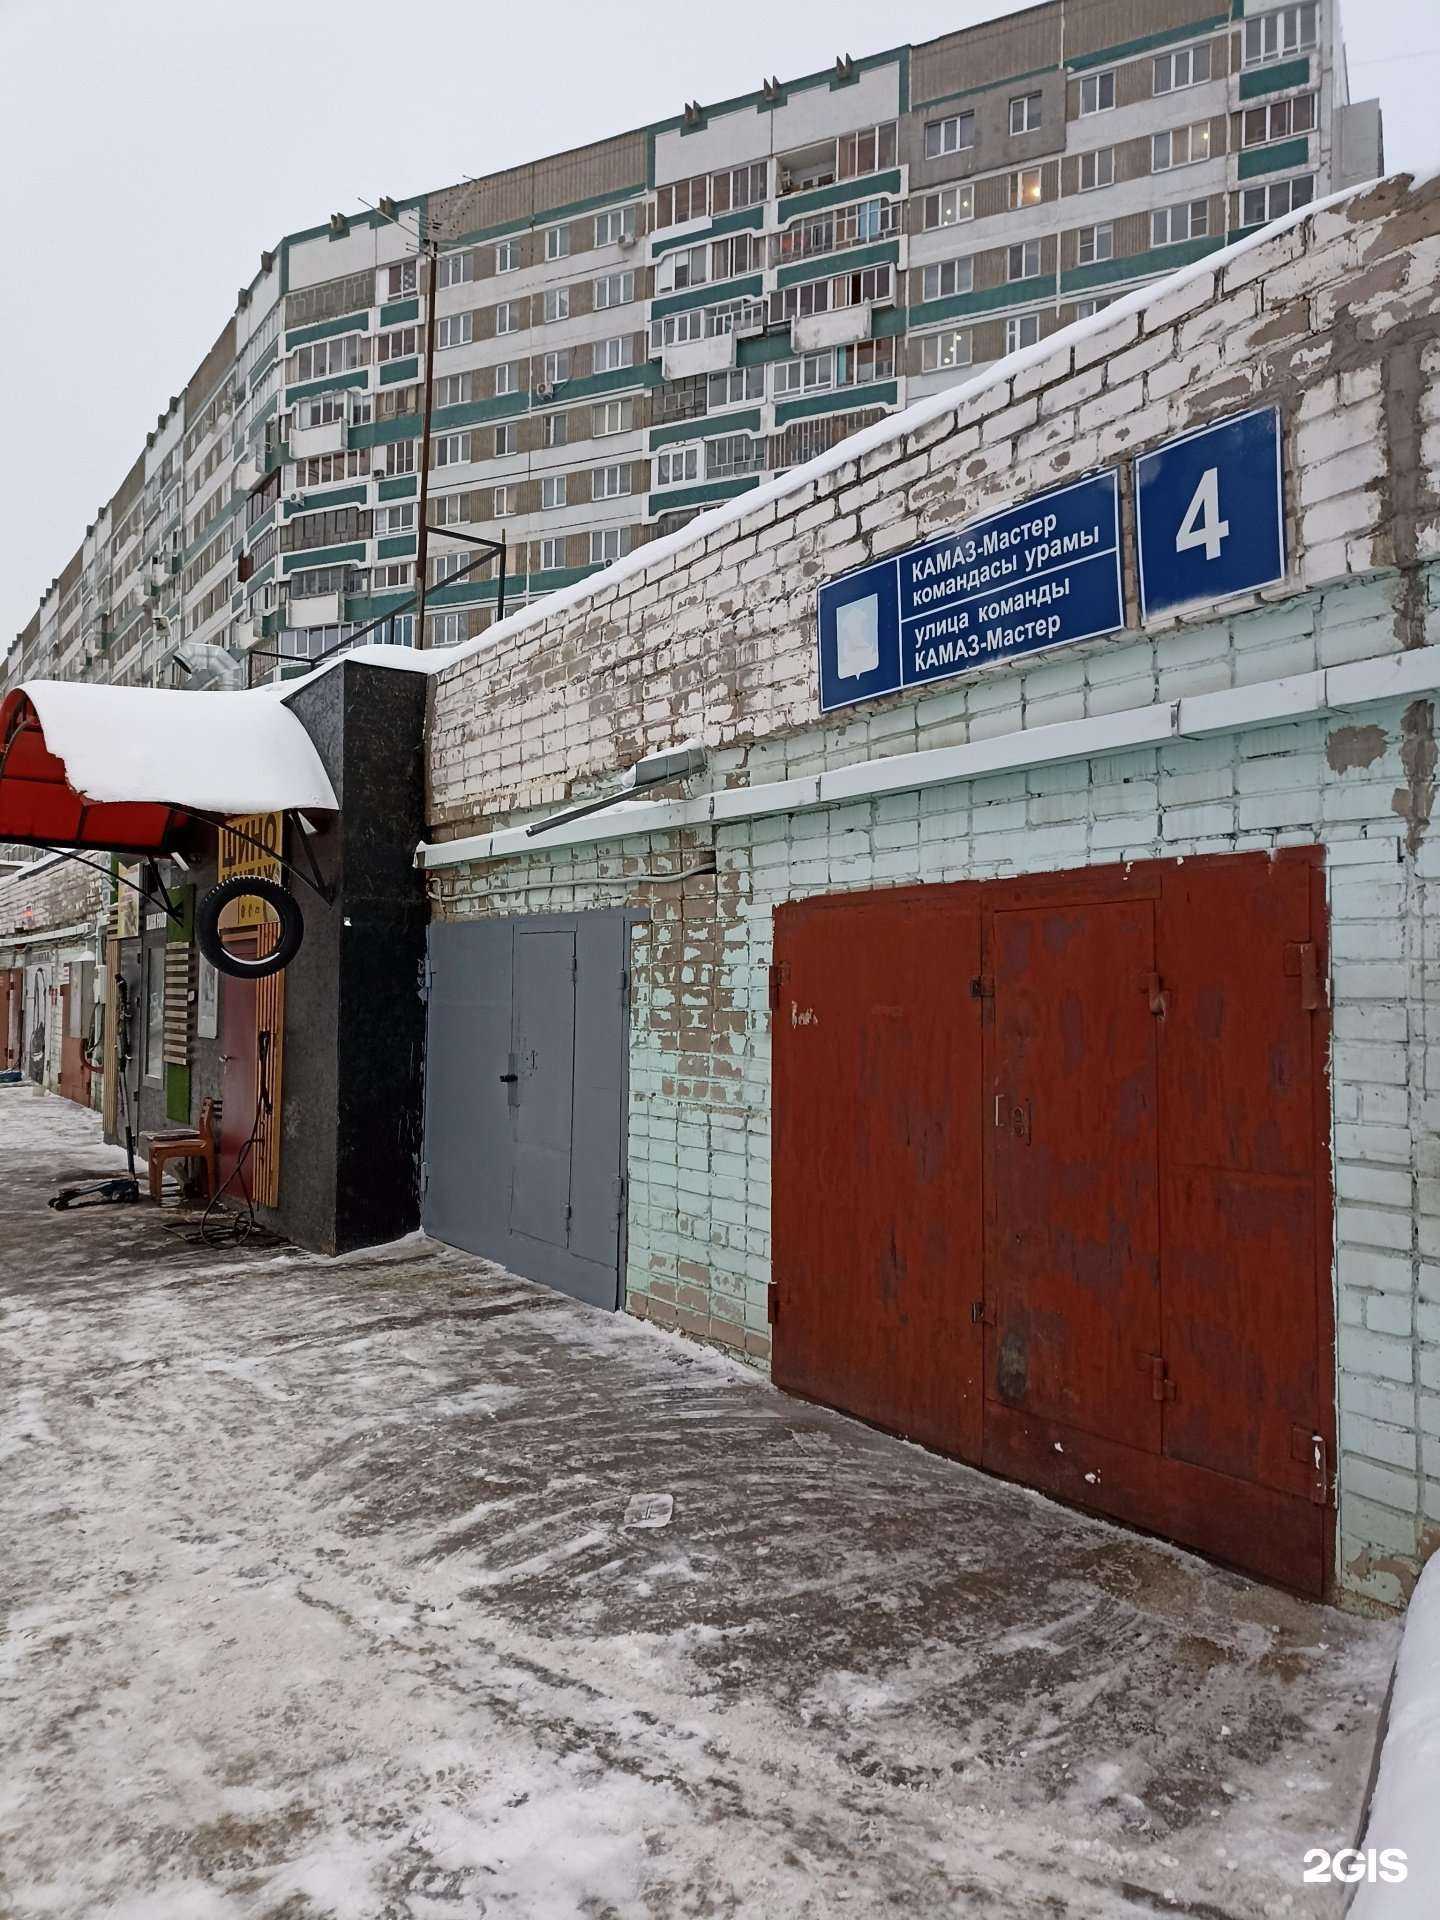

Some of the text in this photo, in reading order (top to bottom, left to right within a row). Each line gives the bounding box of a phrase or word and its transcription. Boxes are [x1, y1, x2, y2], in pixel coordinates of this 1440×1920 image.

[912, 513, 1057, 582] КАМАЗ-Мастер
[1175, 467, 1230, 560] 4
[912, 526, 1099, 606] командасы урамы
[914, 578, 1070, 648] улица команды
[915, 614, 1061, 672] КАМАЗ-Мастер
[222, 814, 277, 867] ШИНО
